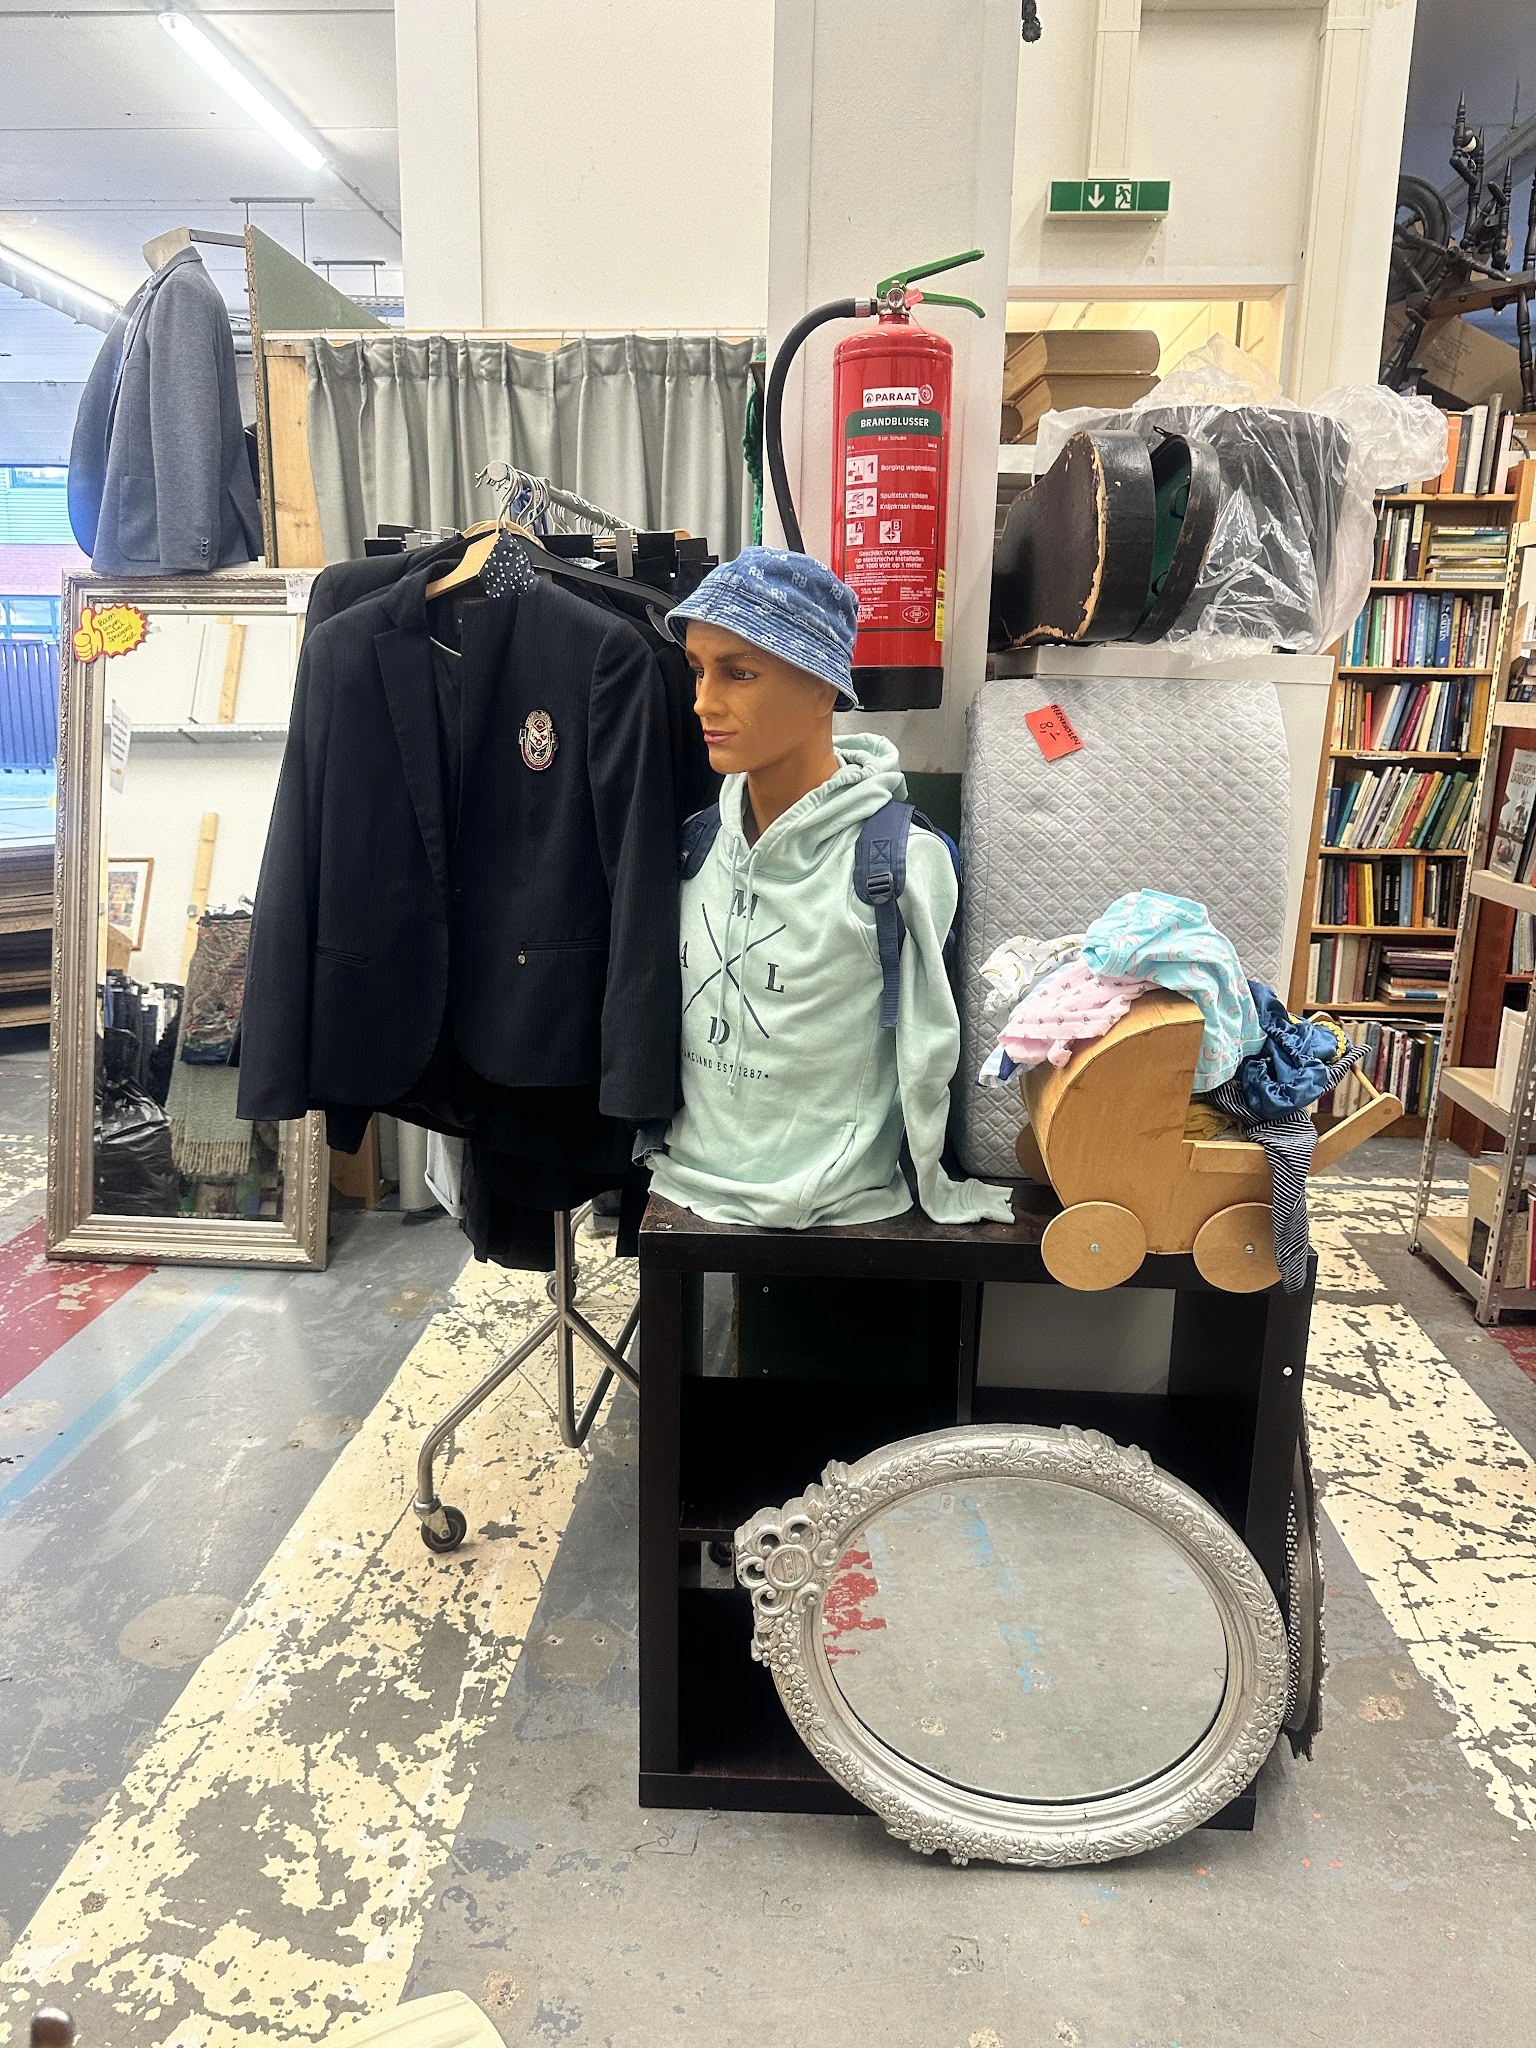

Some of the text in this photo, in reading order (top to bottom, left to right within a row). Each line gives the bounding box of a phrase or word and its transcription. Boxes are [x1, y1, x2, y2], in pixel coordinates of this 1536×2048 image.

[875, 392, 917, 402] PARAAT
[860, 416, 930, 428] BRANDBLUSSER
[867, 462, 874, 474] 1
[880, 464, 937, 473] Borging wegtrekken
[880, 492, 929, 501] Spuitstuk richten
[866, 496, 874, 507] 2
[880, 503, 936, 511] Knijpkraan indrukken
[856, 522, 863, 531] A
[893, 521, 900, 530] B
[898, 549, 921, 557] gebruik
[764, 962, 785, 993] L
[707, 1015, 731, 1045] D
